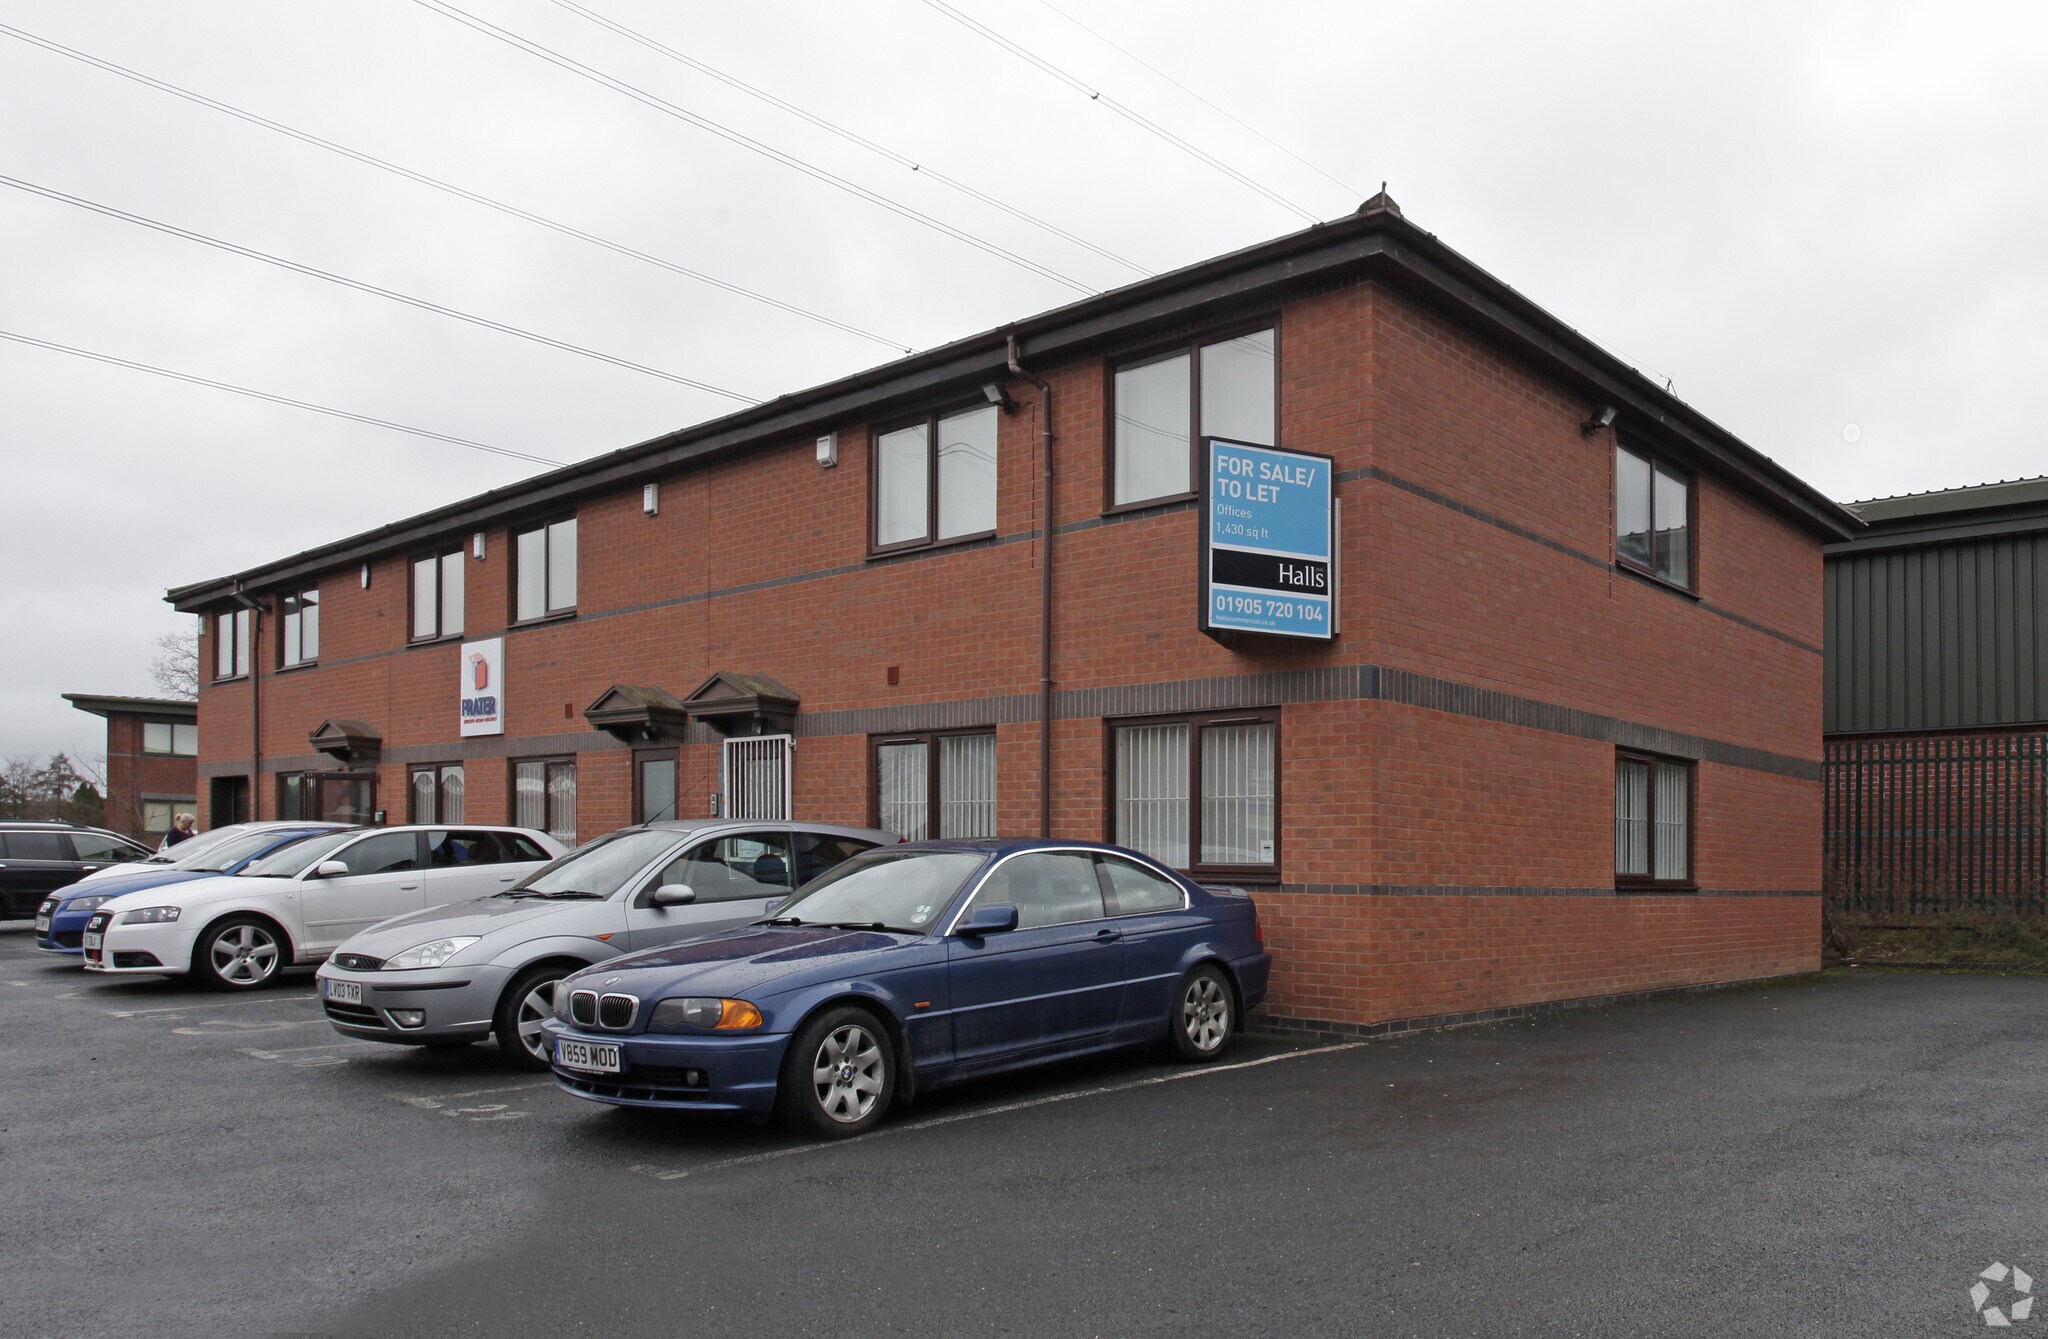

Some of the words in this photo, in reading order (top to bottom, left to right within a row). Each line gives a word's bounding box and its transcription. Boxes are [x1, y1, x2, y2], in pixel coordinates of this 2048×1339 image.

[1217, 455, 1254, 478] FOR
[1260, 462, 1316, 488] SALE/
[1218, 478, 1242, 498] TO
[1246, 482, 1280, 503] LET
[1217, 504, 1252, 519] Offices
[1216, 522, 1244, 535] 1,430
[1246, 528, 1259, 540] sq
[1261, 528, 1269, 538] ft
[1279, 563, 1324, 588] Halls
[1215, 615, 1276, 627] hallscommercial.co.uk
[1216, 595, 1262, 615] 01905
[1266, 601, 1293, 618] 720
[1297, 605, 1322, 622] 104
[561, 1042, 588, 1064] V859
[590, 1047, 617, 1067] MOD
